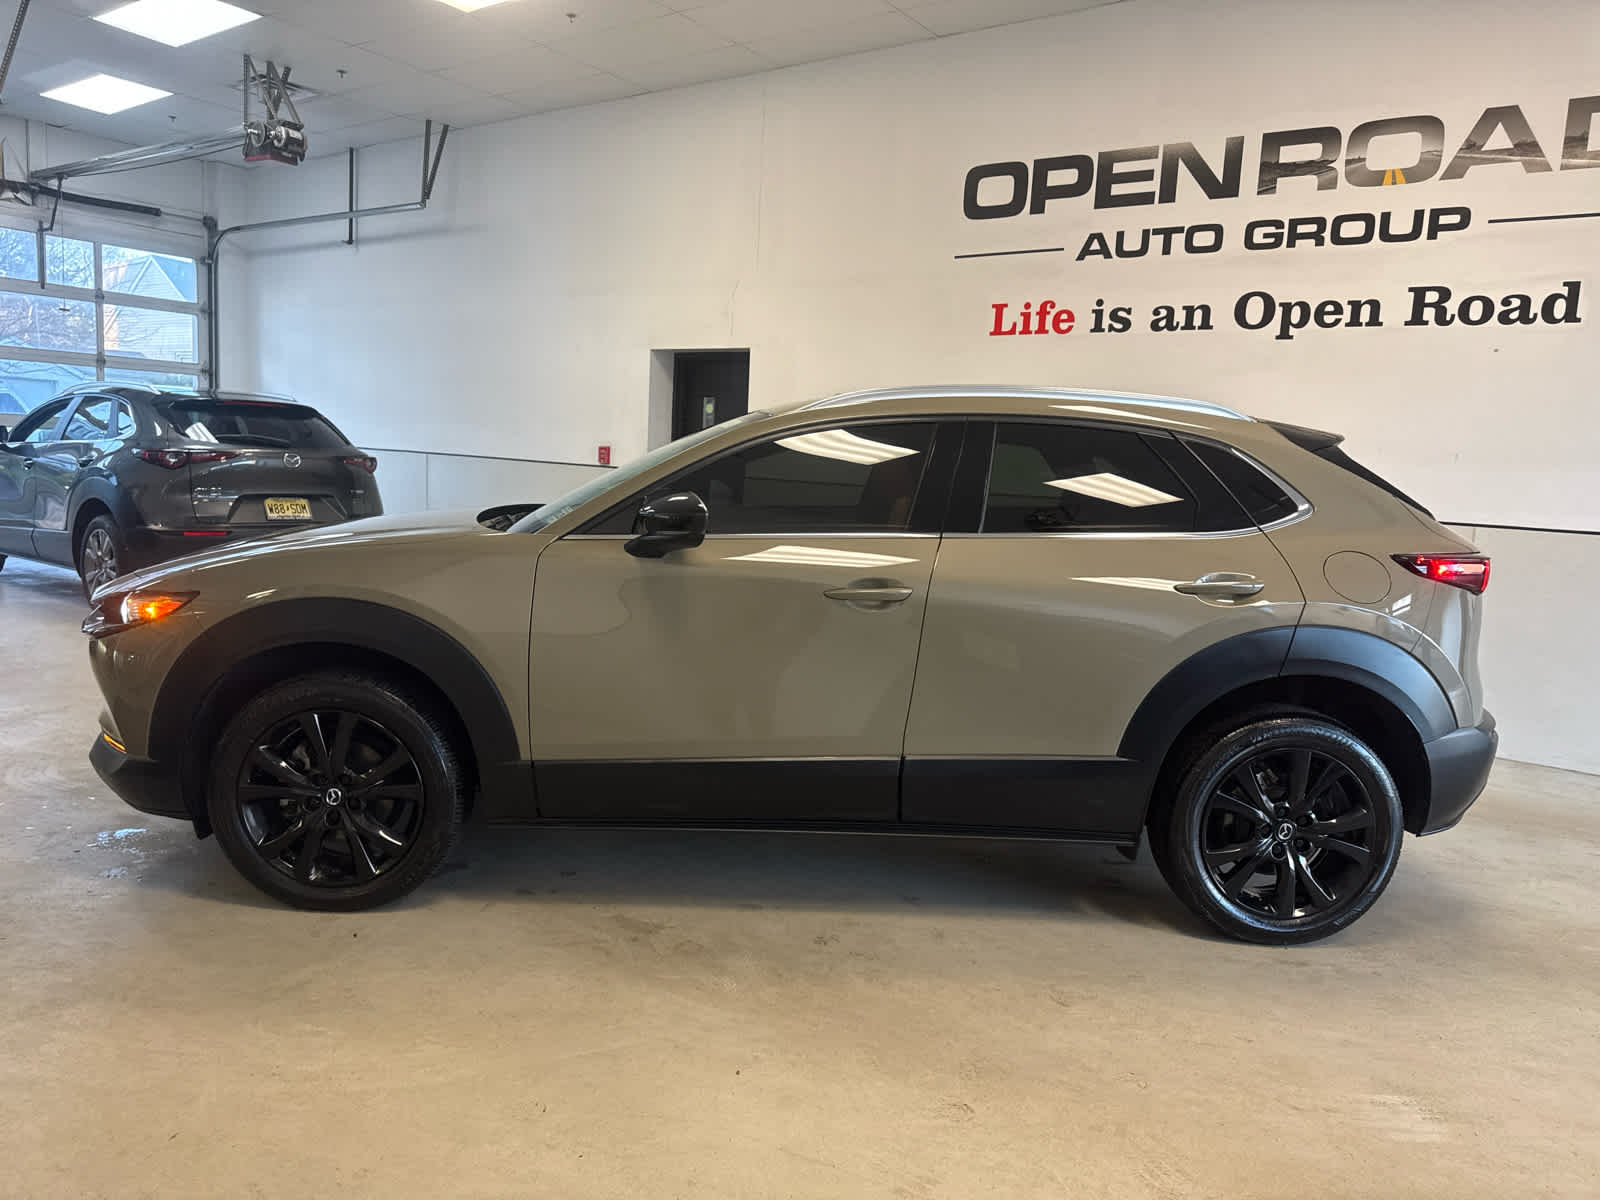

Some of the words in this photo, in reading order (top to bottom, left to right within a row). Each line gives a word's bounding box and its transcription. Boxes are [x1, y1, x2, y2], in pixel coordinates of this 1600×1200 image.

[963, 136, 1245, 221] OPEN
[1075, 223, 1224, 261] AUTO
[1243, 206, 1472, 251] GROUP
[989, 299, 1075, 337] Life
[1089, 298, 1132, 334] is
[1150, 304, 1214, 333] an
[1233, 290, 1384, 341] Open
[1403, 280, 1582, 327] Road
